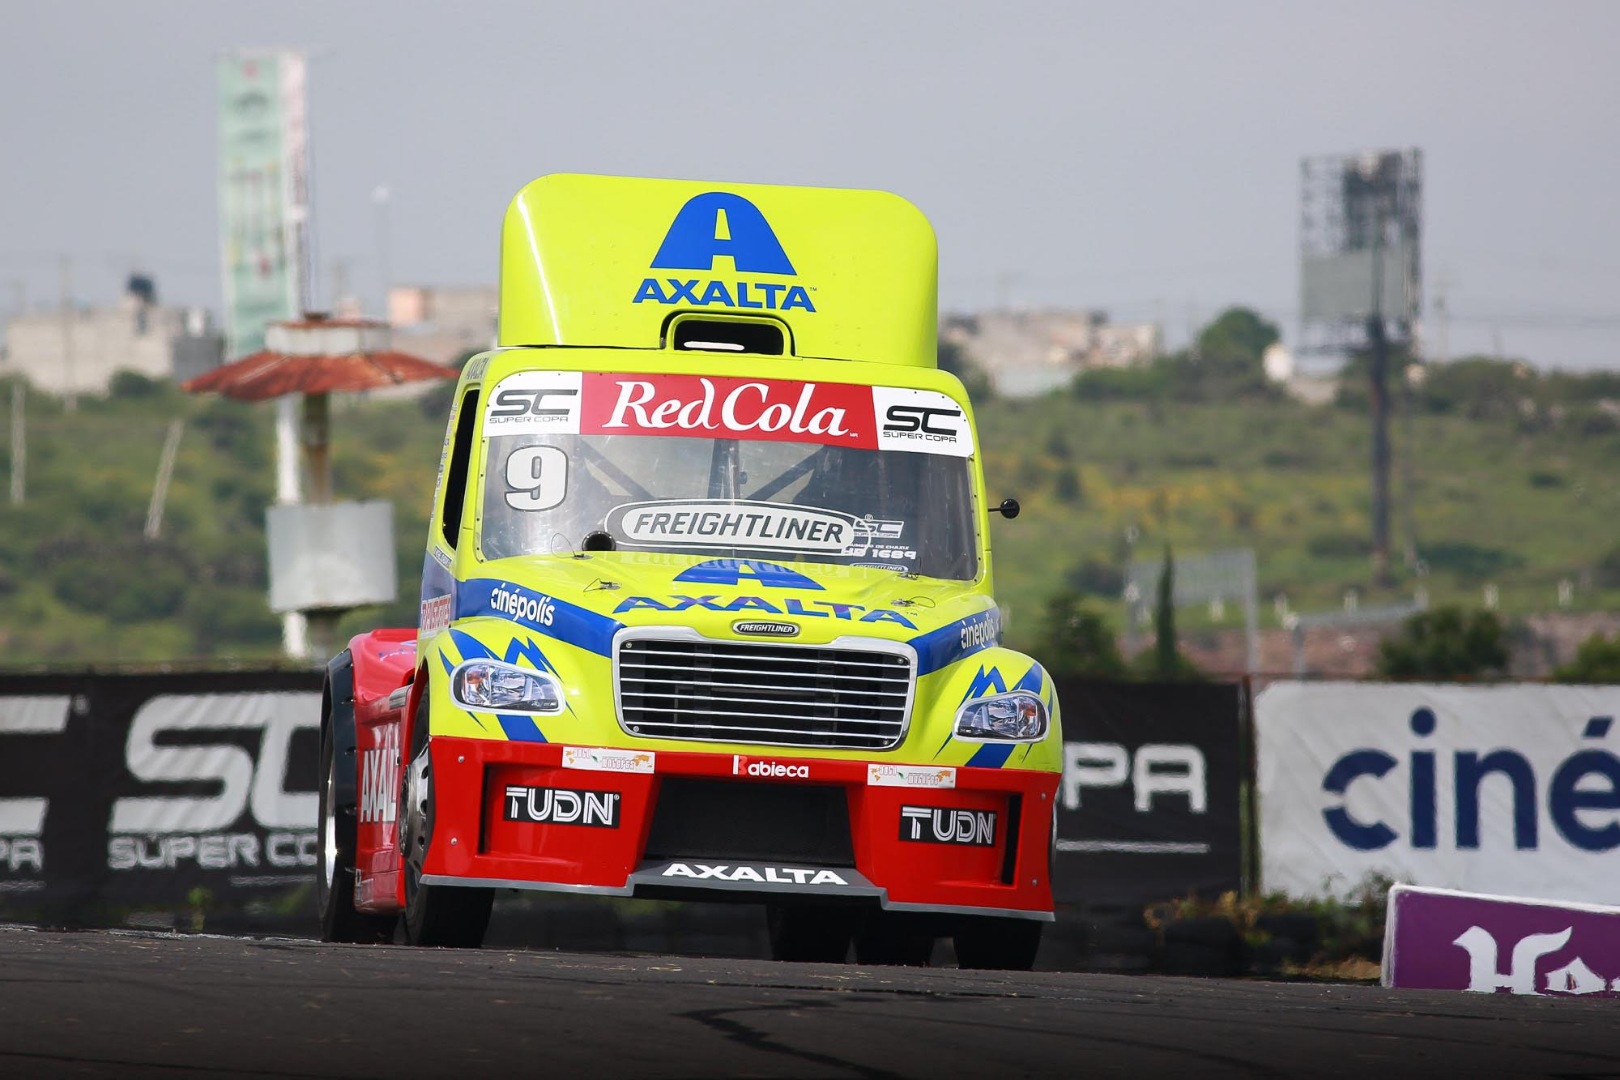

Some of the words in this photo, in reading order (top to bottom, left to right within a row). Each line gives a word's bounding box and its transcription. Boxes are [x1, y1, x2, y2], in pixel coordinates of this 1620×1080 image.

[632, 278, 817, 313] AXALTA
[490, 389, 579, 417] SC
[601, 378, 720, 429] Red
[721, 382, 849, 436] Cola
[489, 416, 532, 424] SUPER
[883, 405, 962, 436] SC
[883, 431, 923, 440] SUPER
[925, 434, 957, 443] COPA
[504, 444, 569, 513] 9
[633, 511, 844, 543] FREIGHTLINER
[872, 549, 917, 560] 1689
[612, 594, 919, 631] AXALTA
[740, 624, 793, 633] FREIGHTLINER
[732, 754, 809, 779] Babieca
[1322, 706, 1620, 851] ciné
[506, 786, 614, 825] TUDN
[902, 806, 994, 845] TUDN
[108, 833, 260, 869] SUPER
[661, 863, 849, 886] AXALTA
